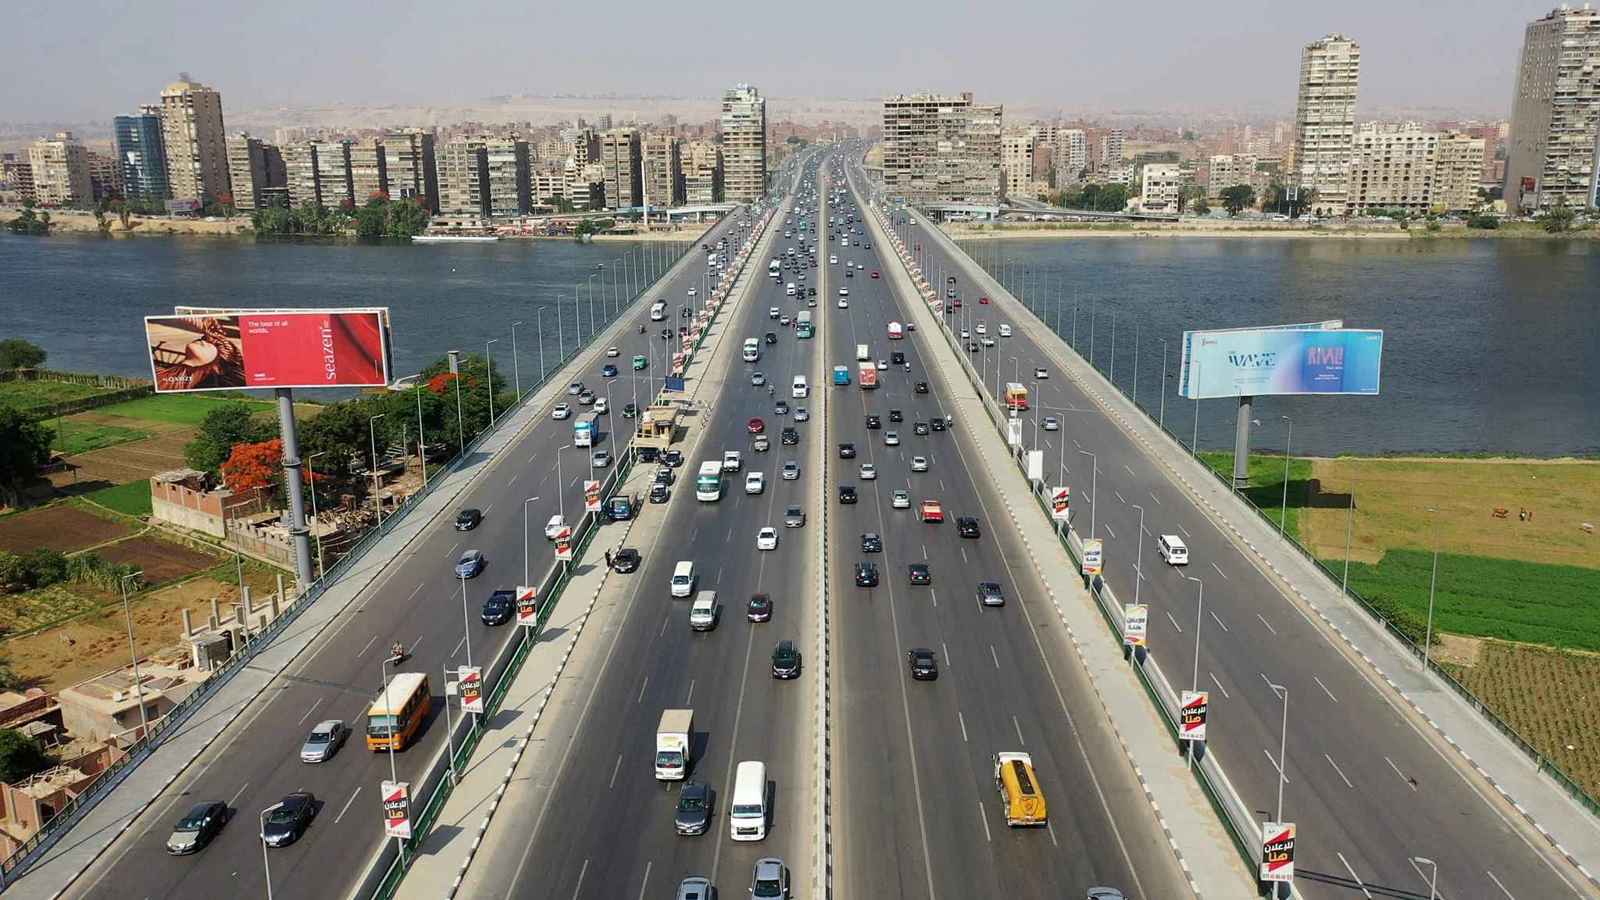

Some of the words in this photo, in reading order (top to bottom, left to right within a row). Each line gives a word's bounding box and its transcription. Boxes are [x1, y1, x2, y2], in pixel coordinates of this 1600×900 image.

[320, 326, 336, 380] seazen
[1228, 352, 1276, 366] WAVE
[388, 810, 404, 818] هنا
[1269, 852, 1288, 862] هنا
